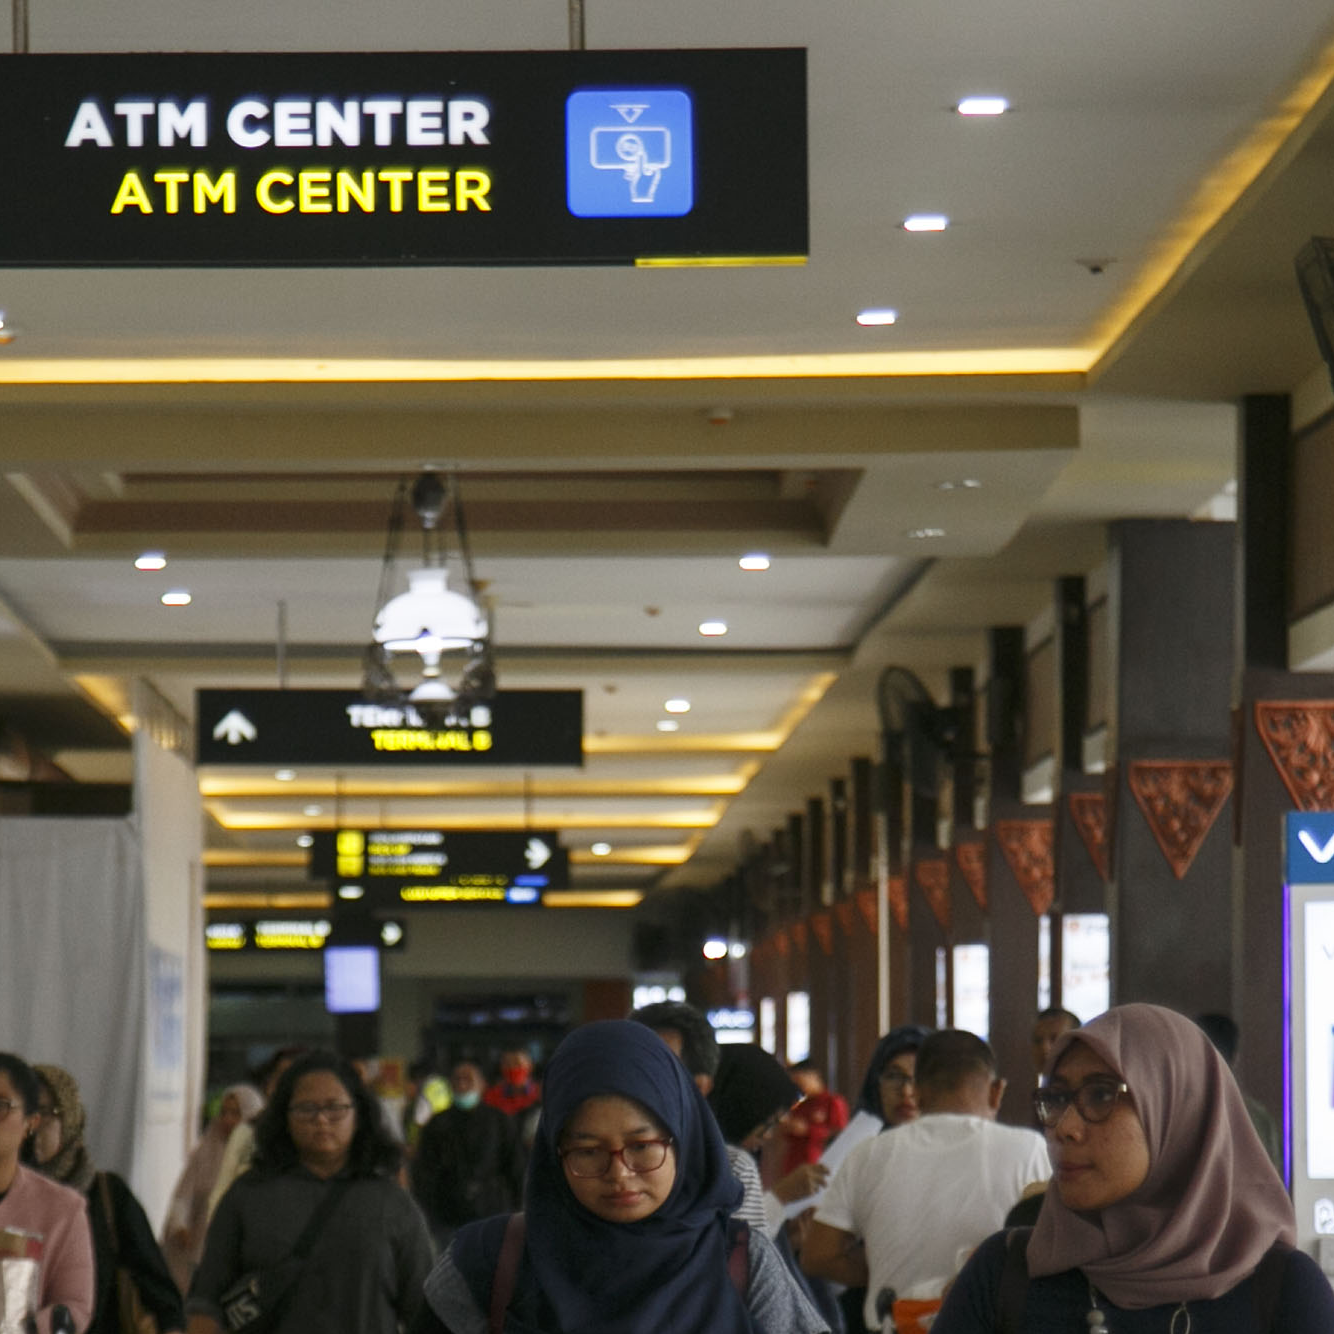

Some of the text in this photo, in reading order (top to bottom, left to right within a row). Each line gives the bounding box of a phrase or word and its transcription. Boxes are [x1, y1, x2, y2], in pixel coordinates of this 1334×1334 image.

[65, 101, 492, 148] ATM CENTER
[110, 171, 492, 214] ATM CENTER
[472, 729, 492, 751] B
